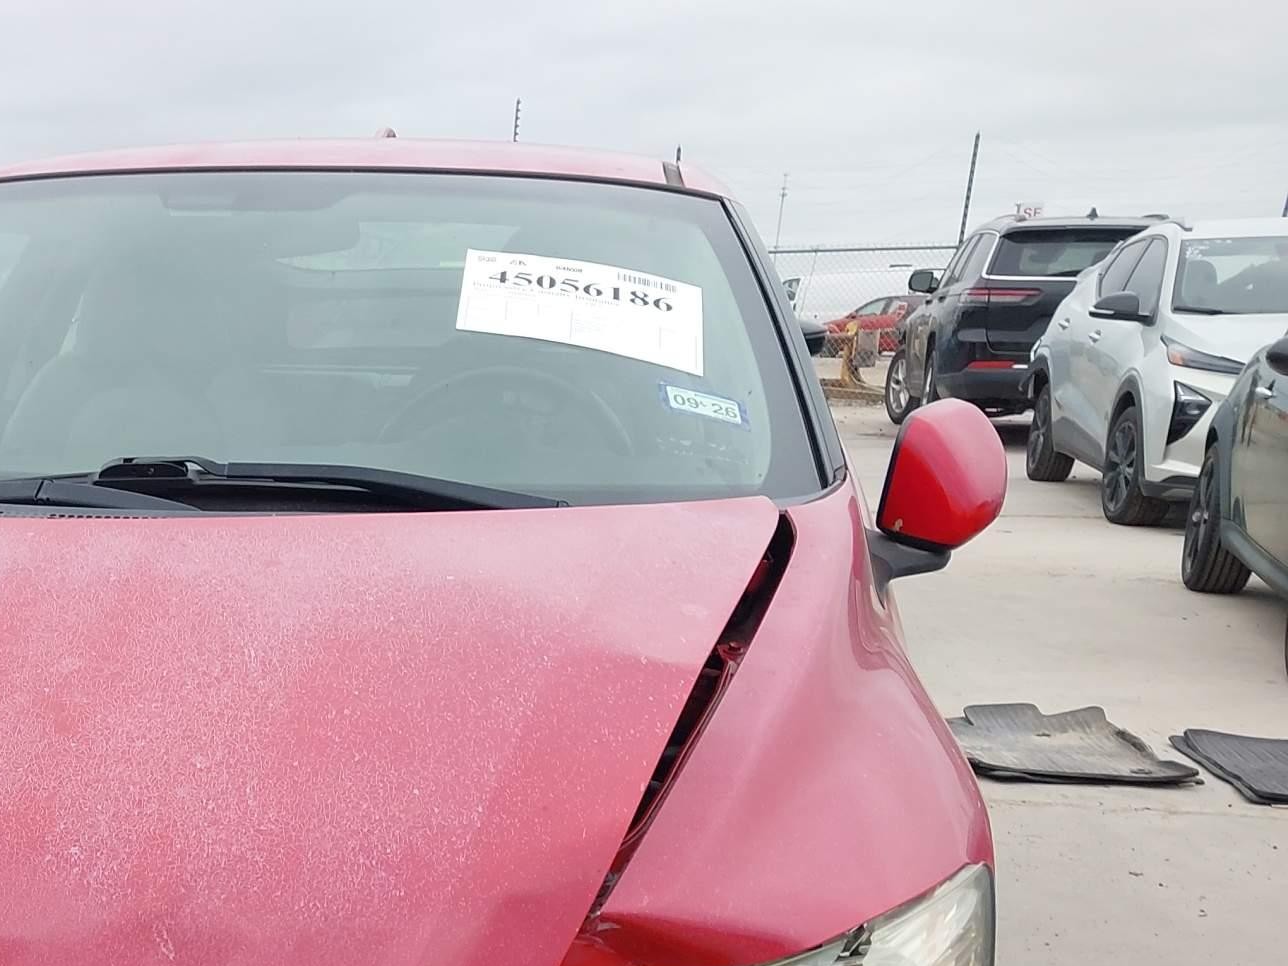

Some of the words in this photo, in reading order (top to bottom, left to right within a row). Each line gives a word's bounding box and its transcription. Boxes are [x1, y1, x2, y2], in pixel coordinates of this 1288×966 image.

[488, 270, 673, 312] 45056186
[673, 393, 699, 409] 09
[712, 403, 738, 419] 26
